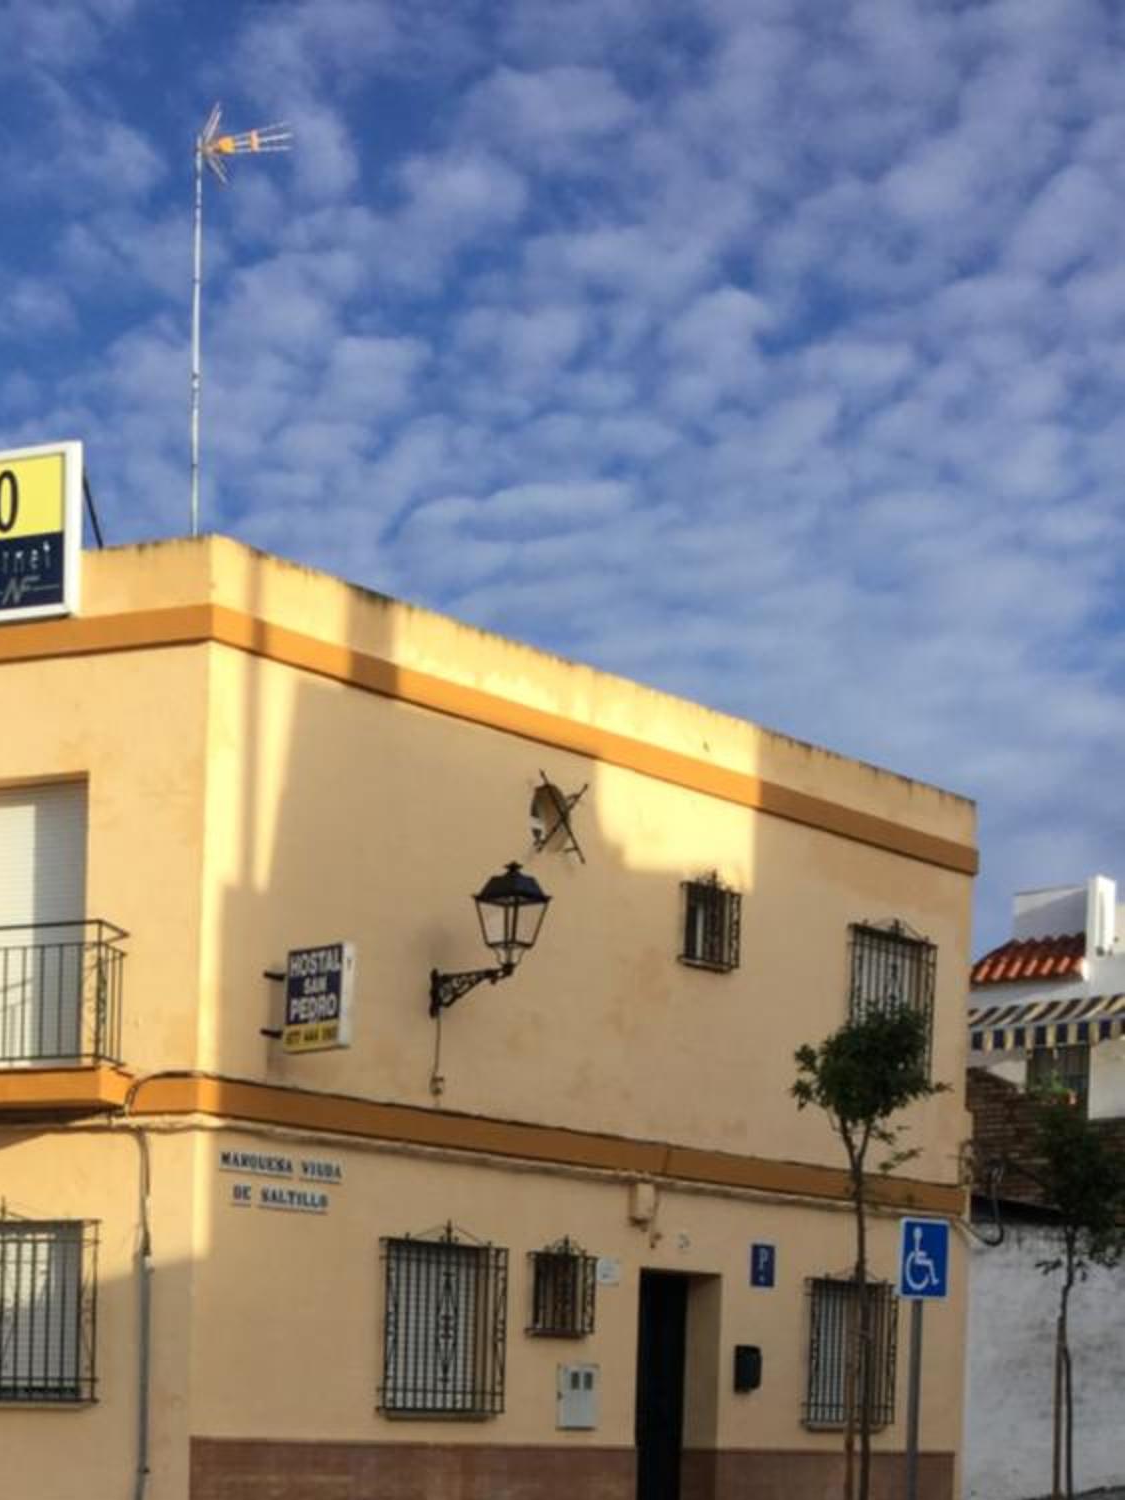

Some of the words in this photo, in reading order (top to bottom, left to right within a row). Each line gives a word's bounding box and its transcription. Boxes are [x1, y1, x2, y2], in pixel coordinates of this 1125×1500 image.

[290, 948, 341, 976] HOSTAL
[304, 975, 328, 995] SAN
[289, 993, 337, 1021] PEDRO
